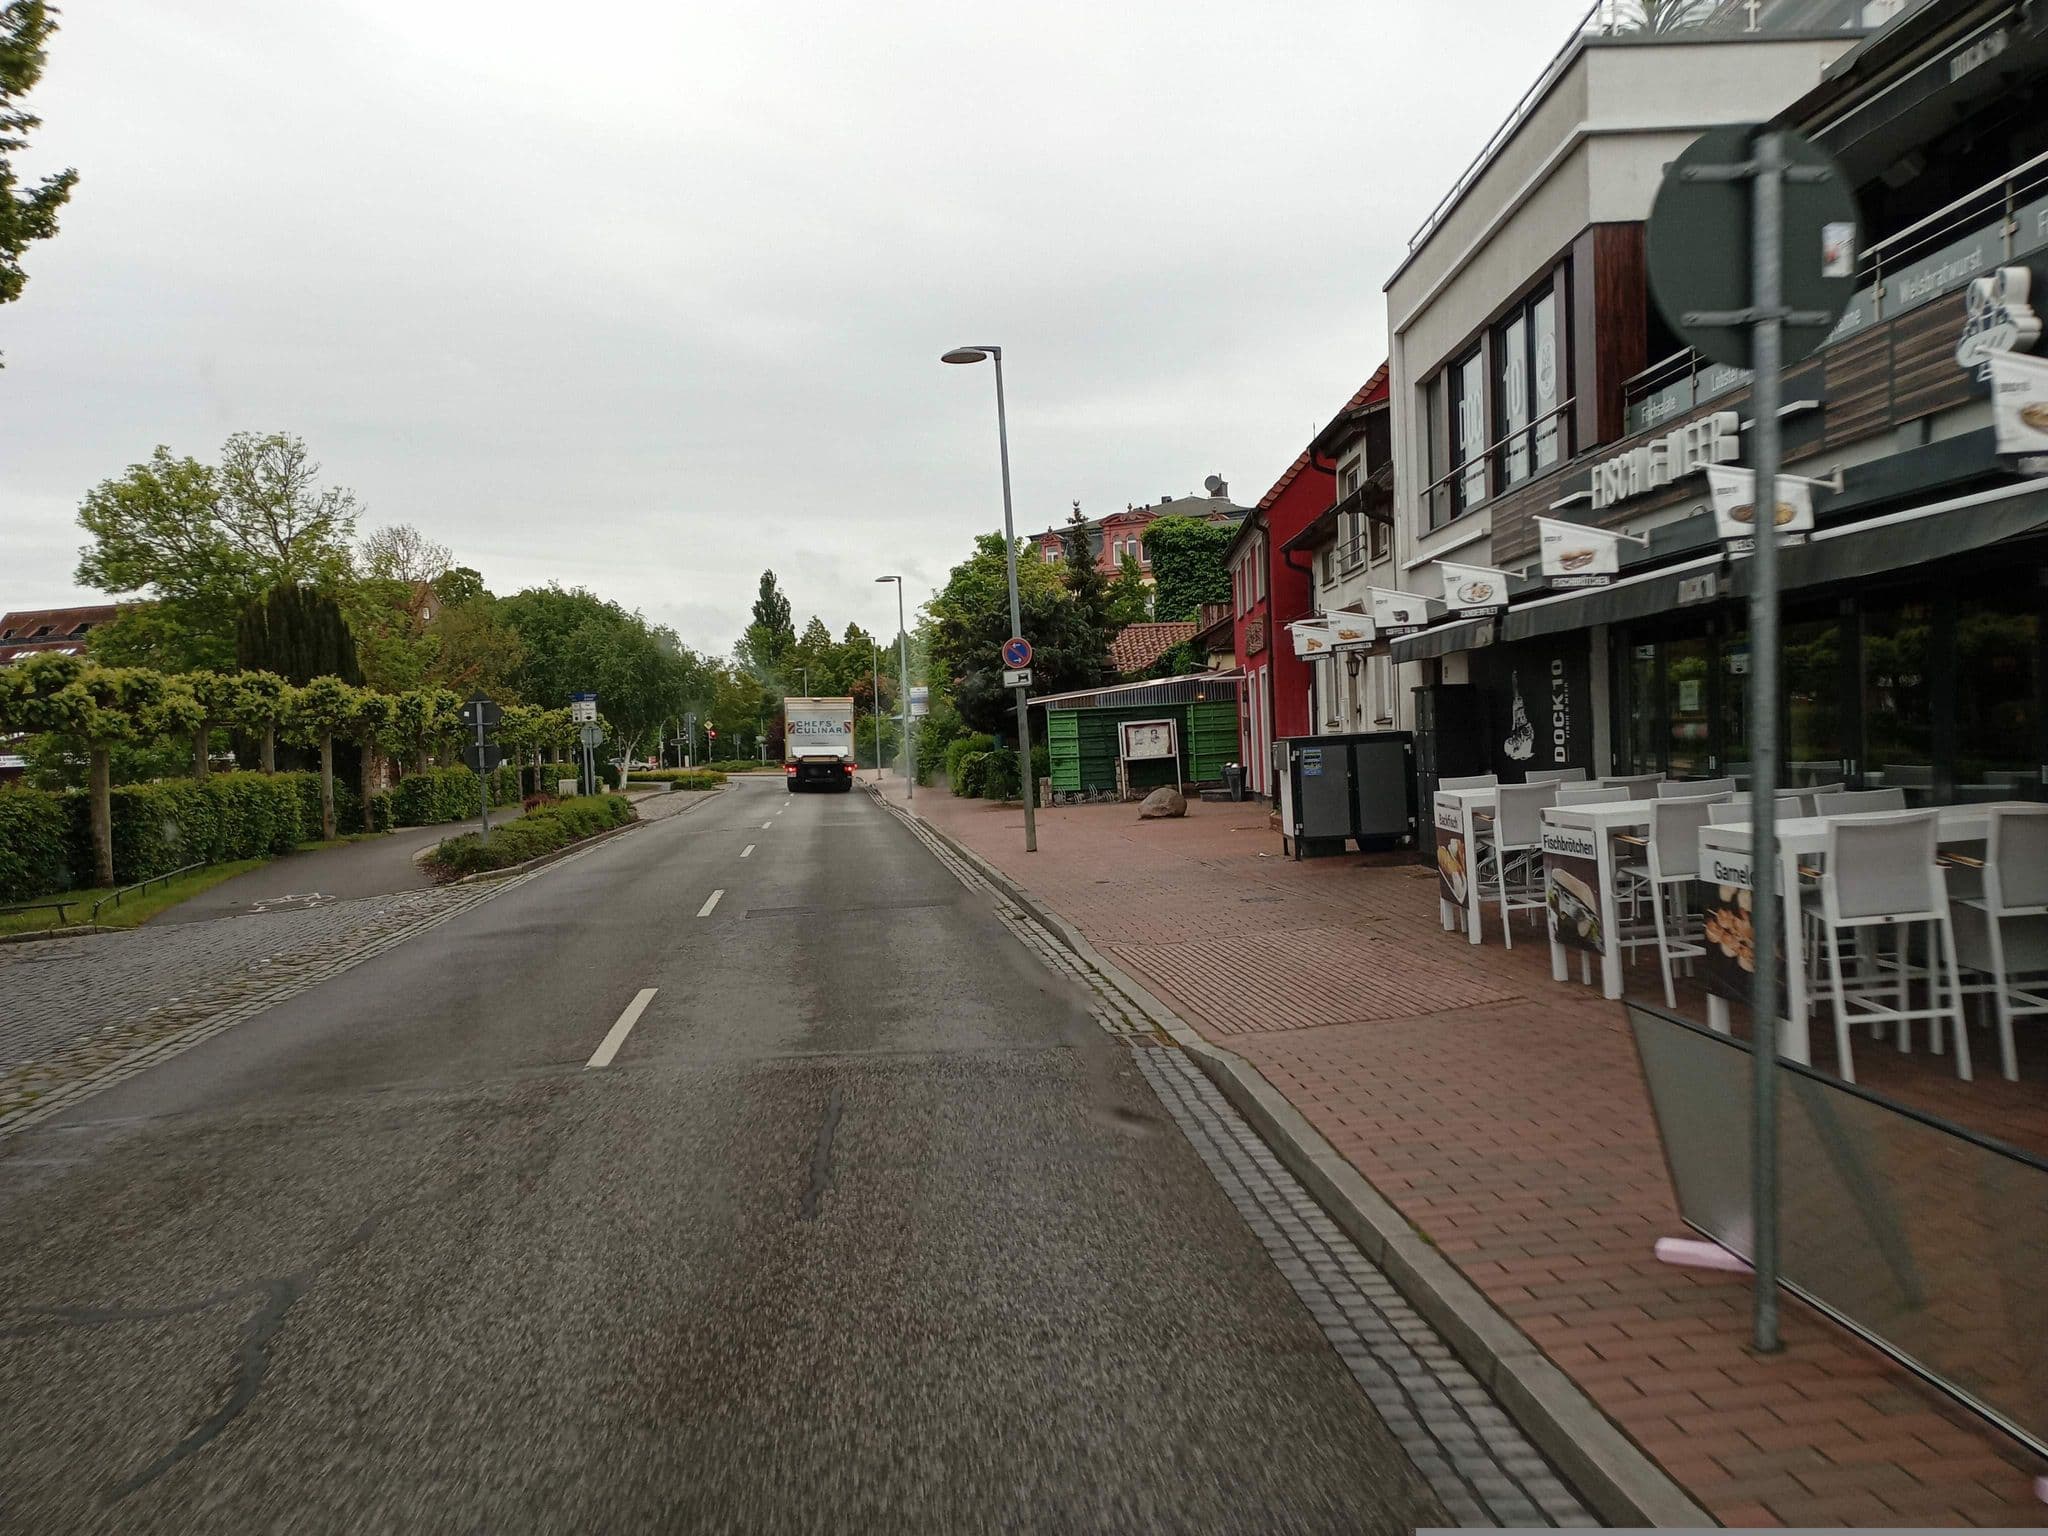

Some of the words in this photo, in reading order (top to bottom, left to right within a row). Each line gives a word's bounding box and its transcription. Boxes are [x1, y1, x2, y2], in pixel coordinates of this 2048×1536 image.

[1591, 446, 1648, 510] FISCH
[1667, 411, 1739, 480] MEER
[1543, 834, 1594, 856] Fischbrötchen
